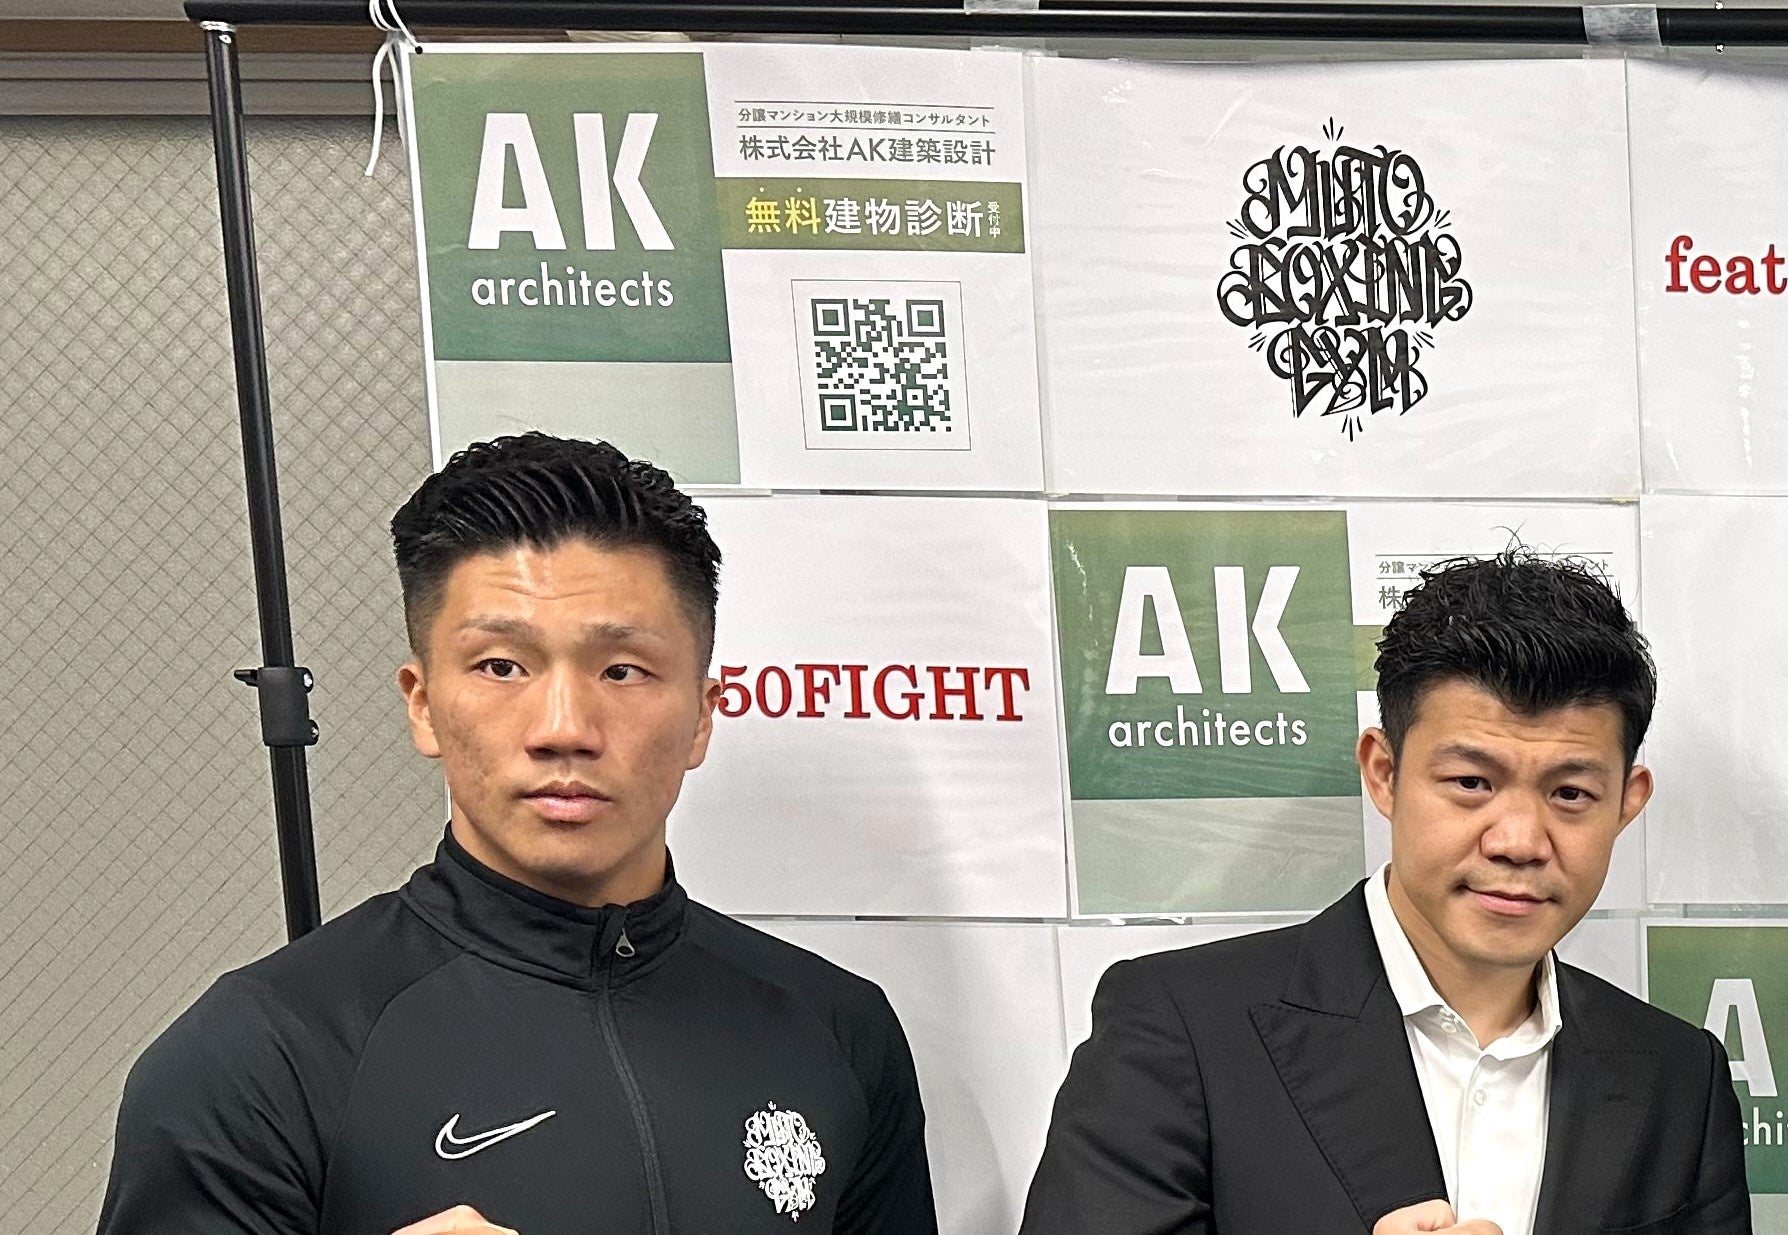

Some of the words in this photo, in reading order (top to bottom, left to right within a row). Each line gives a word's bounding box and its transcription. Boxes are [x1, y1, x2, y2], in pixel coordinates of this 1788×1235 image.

[739, 134, 996, 166] 株式会社AK建築設計
[467, 112, 676, 251] AK
[471, 262, 675, 308] architects
[1105, 565, 1311, 696] AK
[1108, 705, 1308, 747] architects
